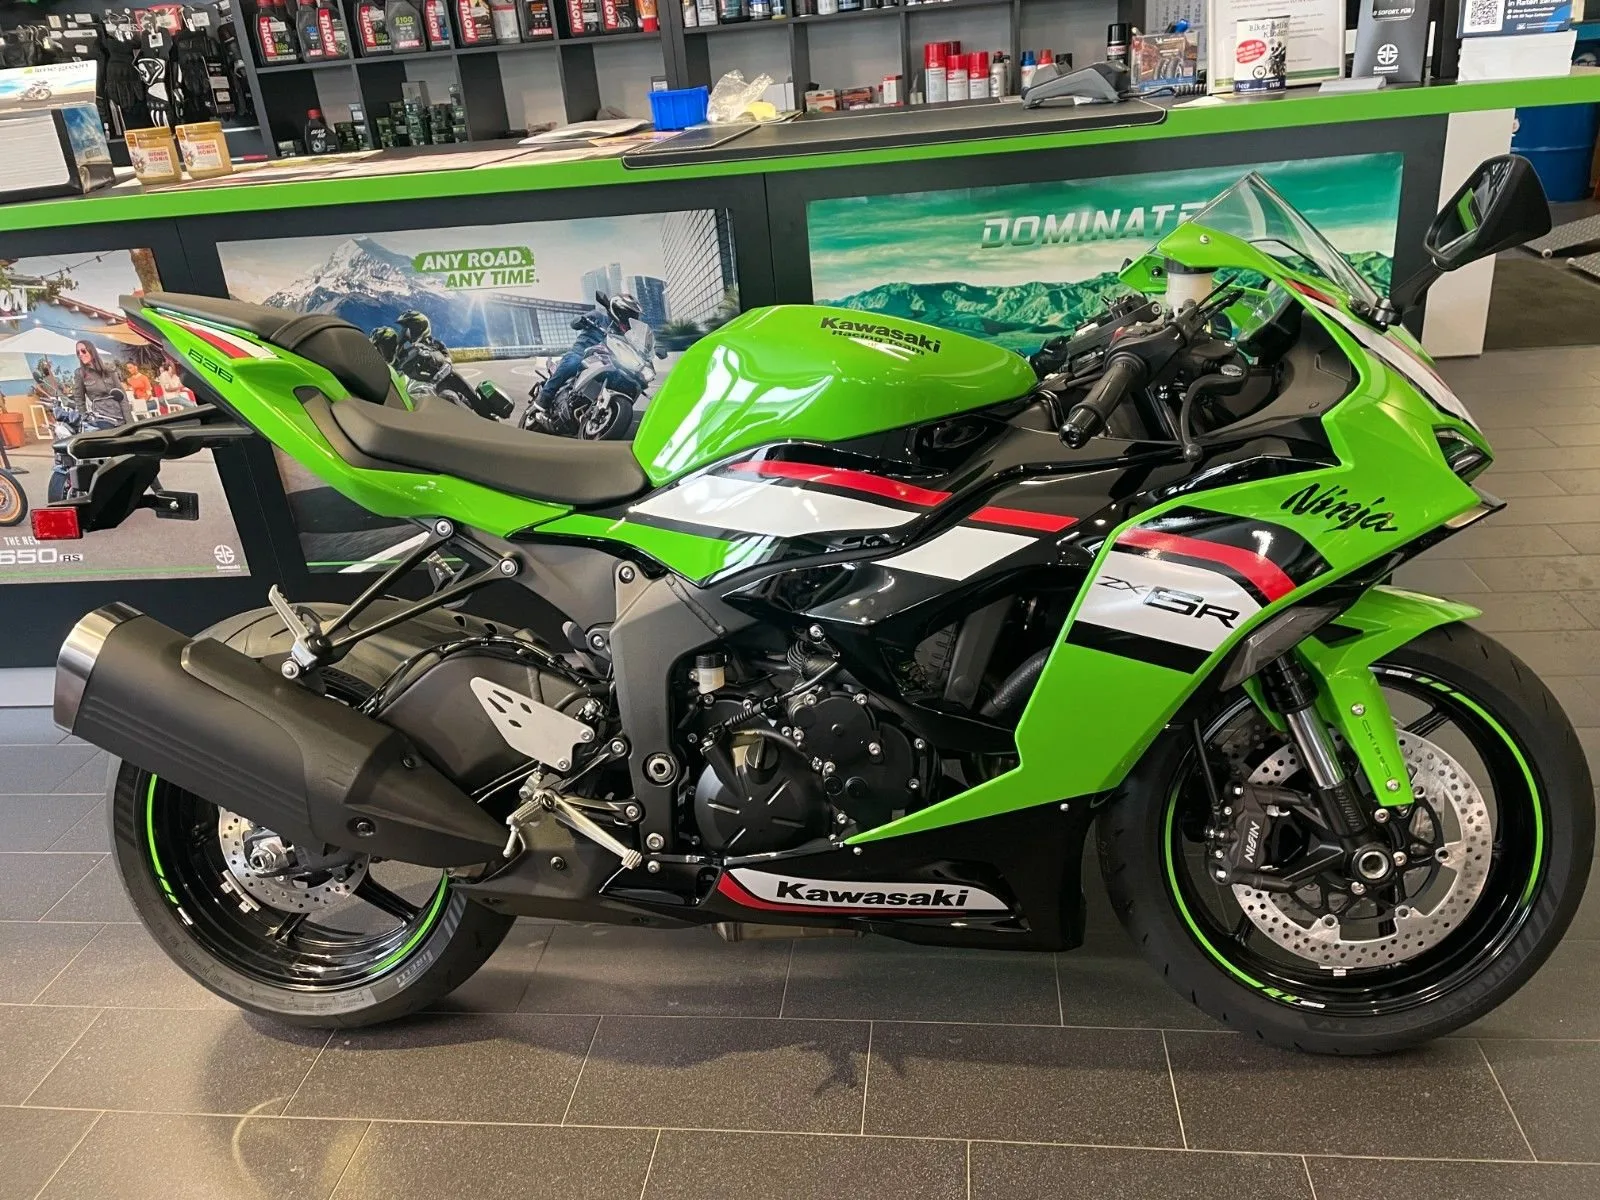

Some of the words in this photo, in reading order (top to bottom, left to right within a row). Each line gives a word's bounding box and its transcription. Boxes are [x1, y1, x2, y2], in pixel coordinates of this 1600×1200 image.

[260, 20, 275, 53] MOTUL
[320, 15, 337, 53] MOTUL
[361, 11, 375, 44] MOTUL
[427, 4, 440, 38] MOTUL
[460, 0, 475, 39] MOTUL
[422, 253, 463, 271] ANY
[467, 249, 527, 268] ROAD.
[445, 272, 486, 288] ANY
[490, 269, 540, 285] TIME.
[820, 317, 942, 354] Kawasaki
[832, 330, 883, 343] Racing
[883, 338, 926, 356] Team
[188, 348, 234, 384] 636
[1280, 482, 1399, 533] Ninja
[3, 536, 21, 546] THE
[1244, 820, 1261, 864] NISSIN
[776, 880, 969, 907] Kawasaki
[395, 949, 433, 988] PIRELLI
